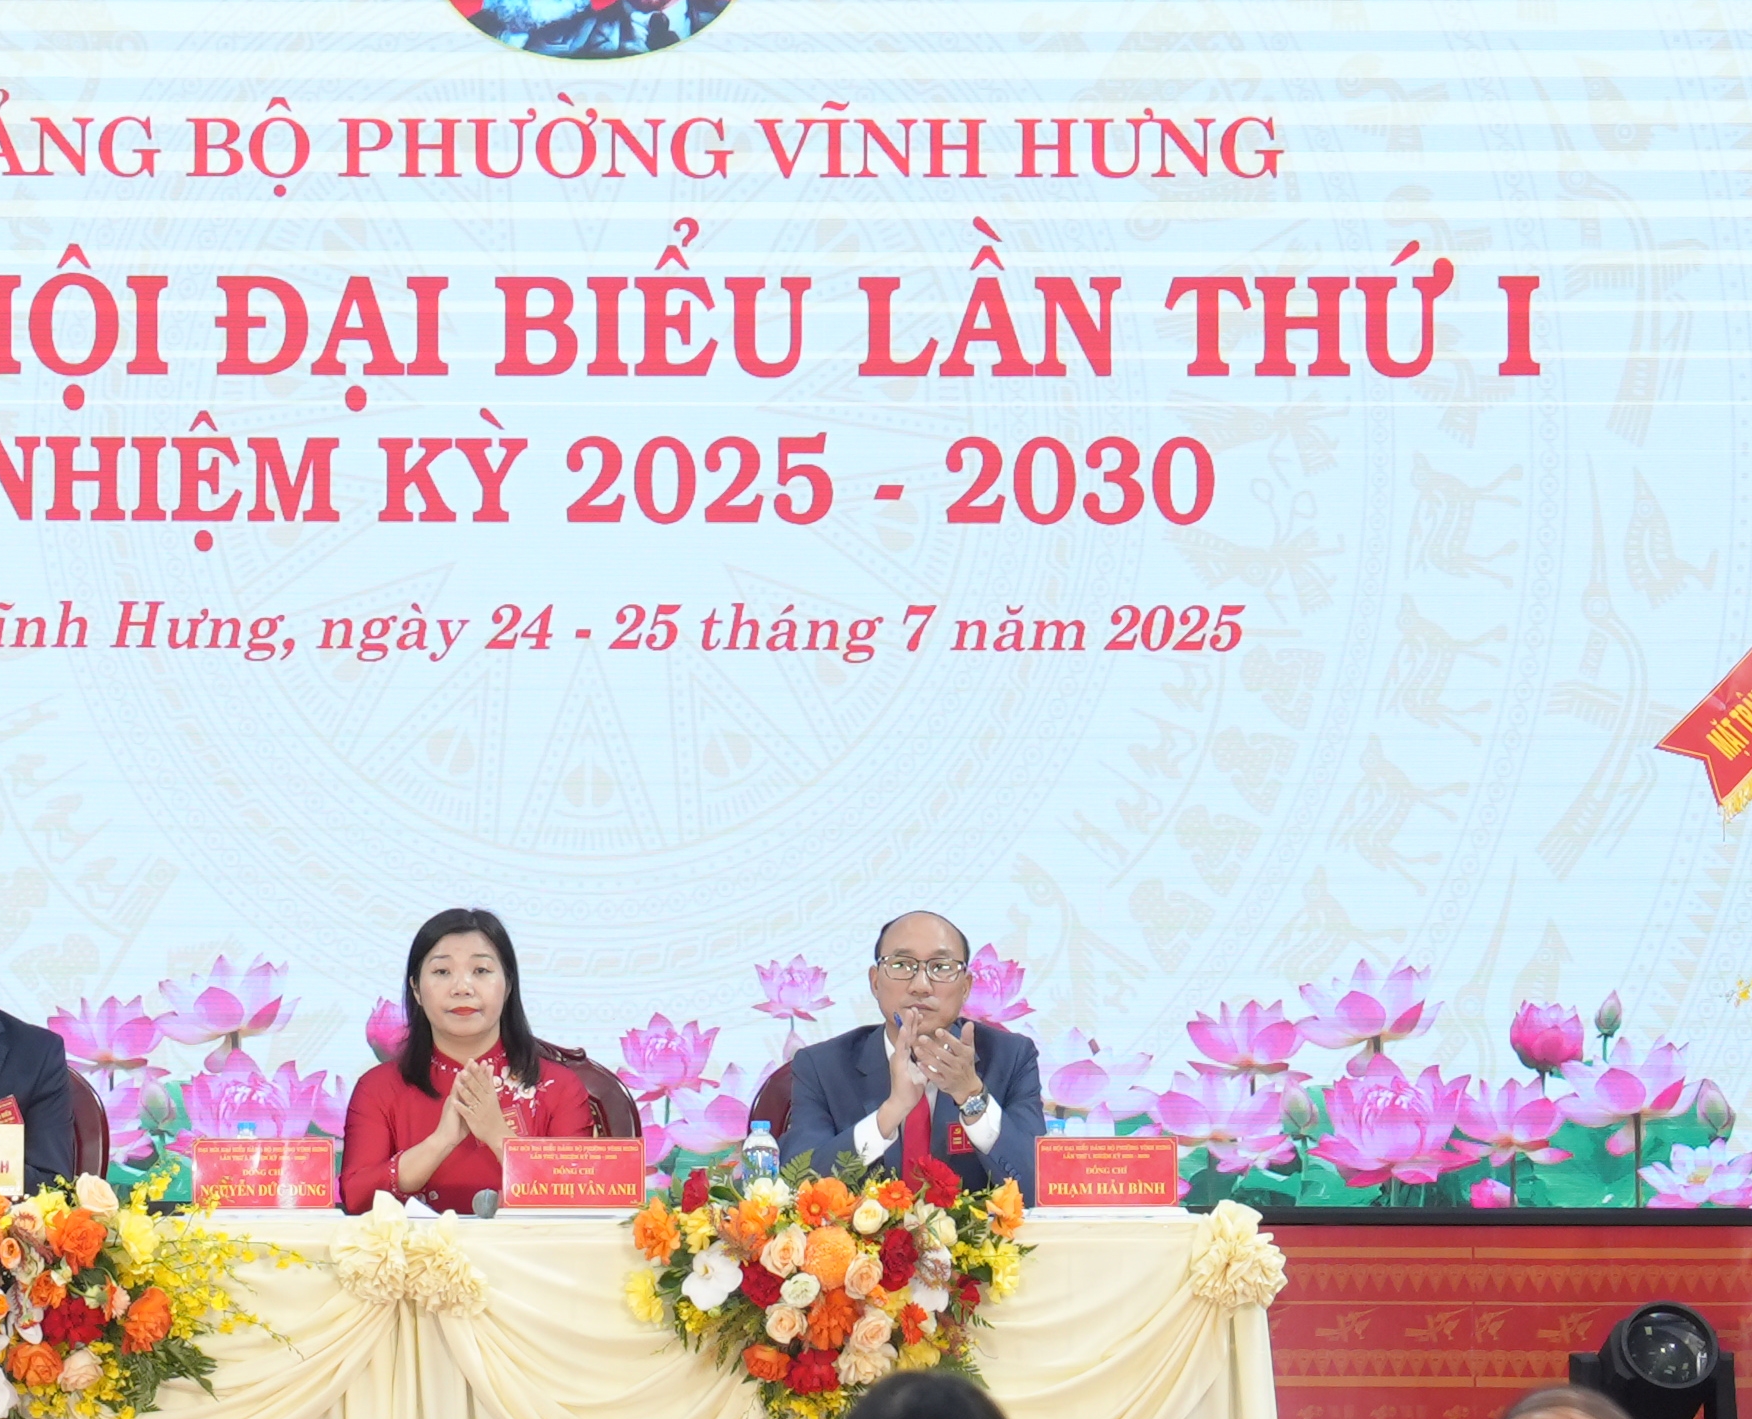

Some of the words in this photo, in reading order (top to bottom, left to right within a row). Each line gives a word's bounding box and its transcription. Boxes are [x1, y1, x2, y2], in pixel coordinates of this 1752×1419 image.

[188, 97, 311, 197] BỘ
[340, 92, 734, 179] PHƯỜNG
[755, 100, 986, 179] VĨNH
[1016, 107, 1283, 179] HƯNG
[215, 275, 449, 412] ĐẠI
[495, 217, 813, 379] BIỂU
[859, 216, 1122, 377] LẦN
[1165, 248, 1455, 379] THỨ
[1498, 275, 1541, 377] I
[378, 408, 529, 523] KỲ
[567, 432, 833, 525] 2025
[945, 436, 1216, 526] 2030
[113, 600, 296, 661] Hưng,
[318, 602, 457, 663] ngày
[485, 603, 553, 650] 24
[609, 603, 681, 651] 25
[701, 602, 885, 664] tháng
[905, 605, 937, 652] 7
[952, 607, 1086, 653] năm
[1105, 605, 1245, 652] 2025
[1706, 716, 1750, 761] MẶT
[551, 1183, 574, 1198] THỊ
[608, 1184, 636, 1195] ANH
[1048, 1183, 1093, 1198] PHẠM
[1097, 1179, 1124, 1195] HẢI
[1128, 1179, 1165, 1195] BÌNH
